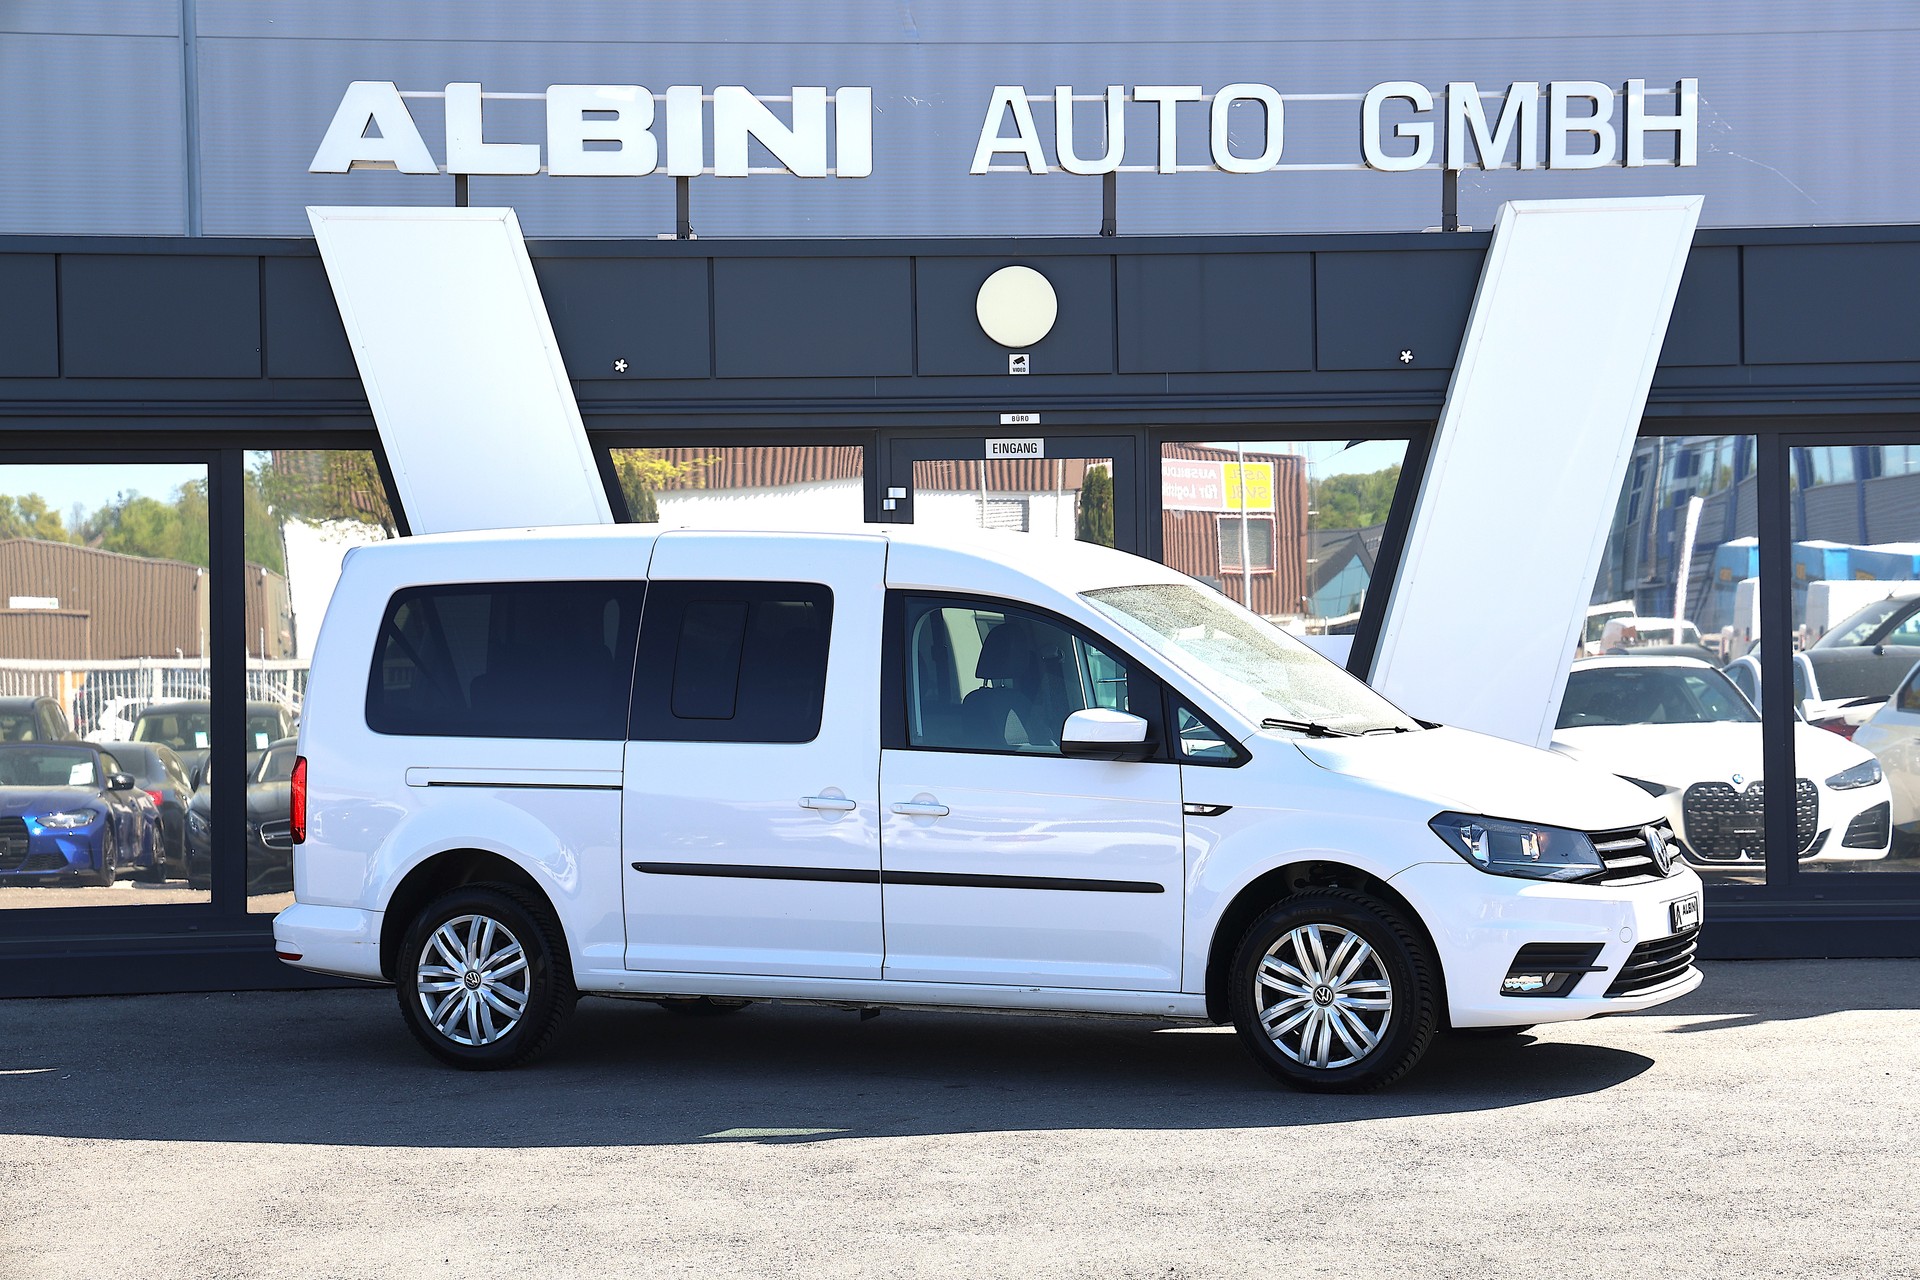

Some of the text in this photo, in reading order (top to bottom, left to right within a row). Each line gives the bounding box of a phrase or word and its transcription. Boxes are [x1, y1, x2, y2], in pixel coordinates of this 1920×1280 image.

[308, 77, 1698, 178] ALBINI AUTO GMBH
[1011, 414, 1030, 422] BÜRO
[992, 442, 1038, 454] EINGANG
